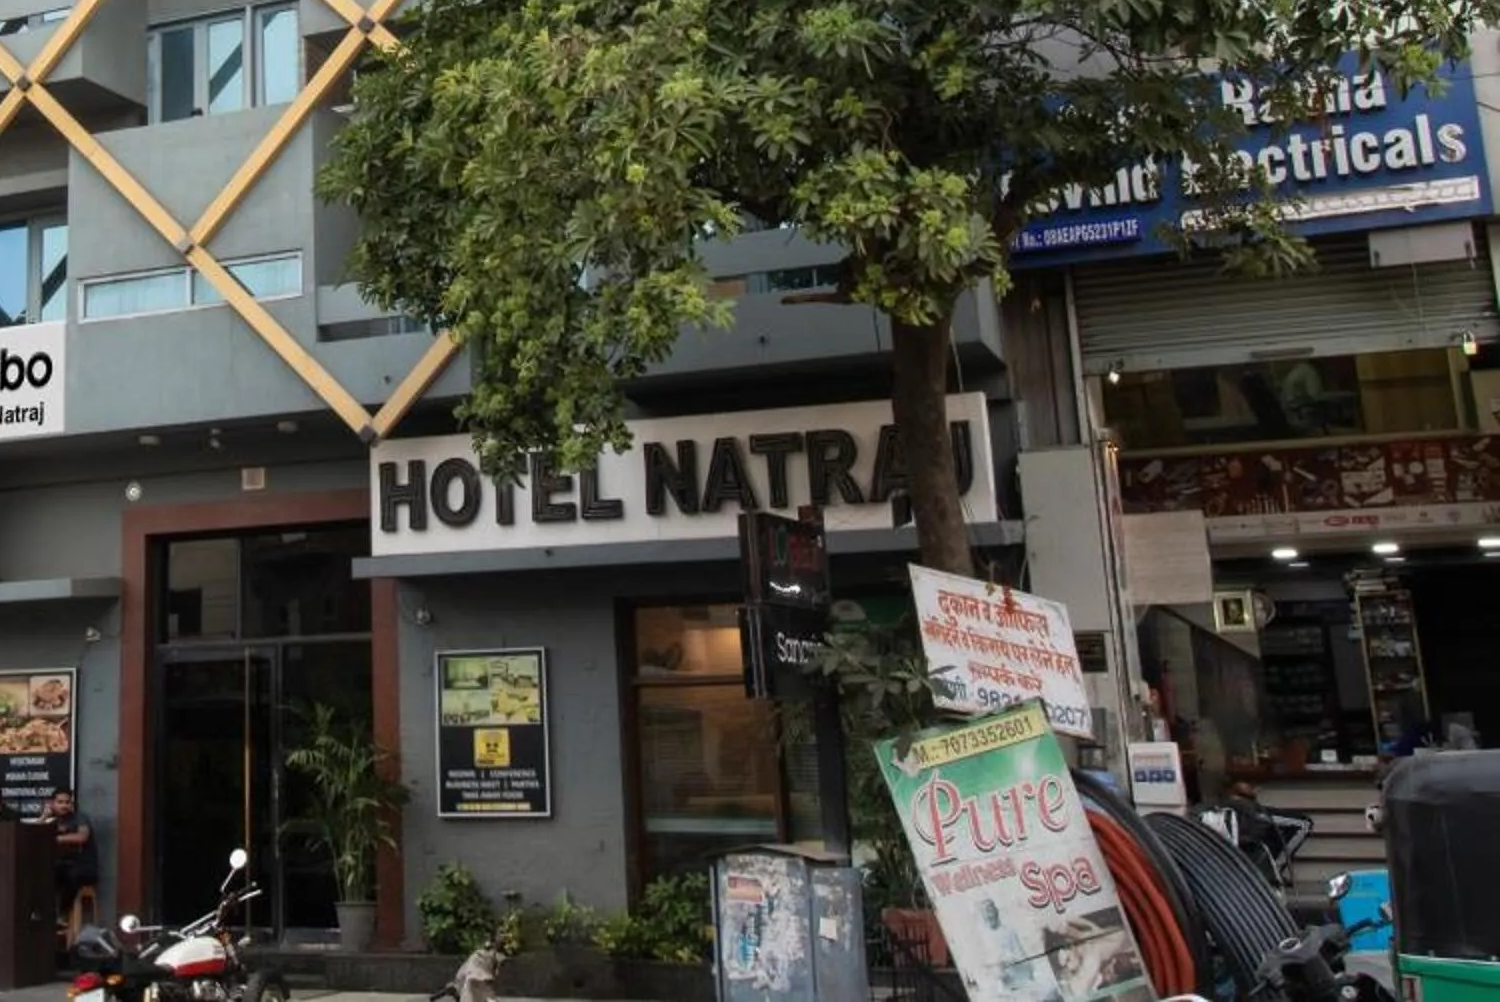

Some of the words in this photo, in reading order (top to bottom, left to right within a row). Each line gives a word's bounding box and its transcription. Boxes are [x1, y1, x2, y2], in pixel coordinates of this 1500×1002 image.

[1181, 113, 1468, 195] ectricals
[378, 446, 625, 534] HOTEL
[913, 769, 1071, 867] Pure
